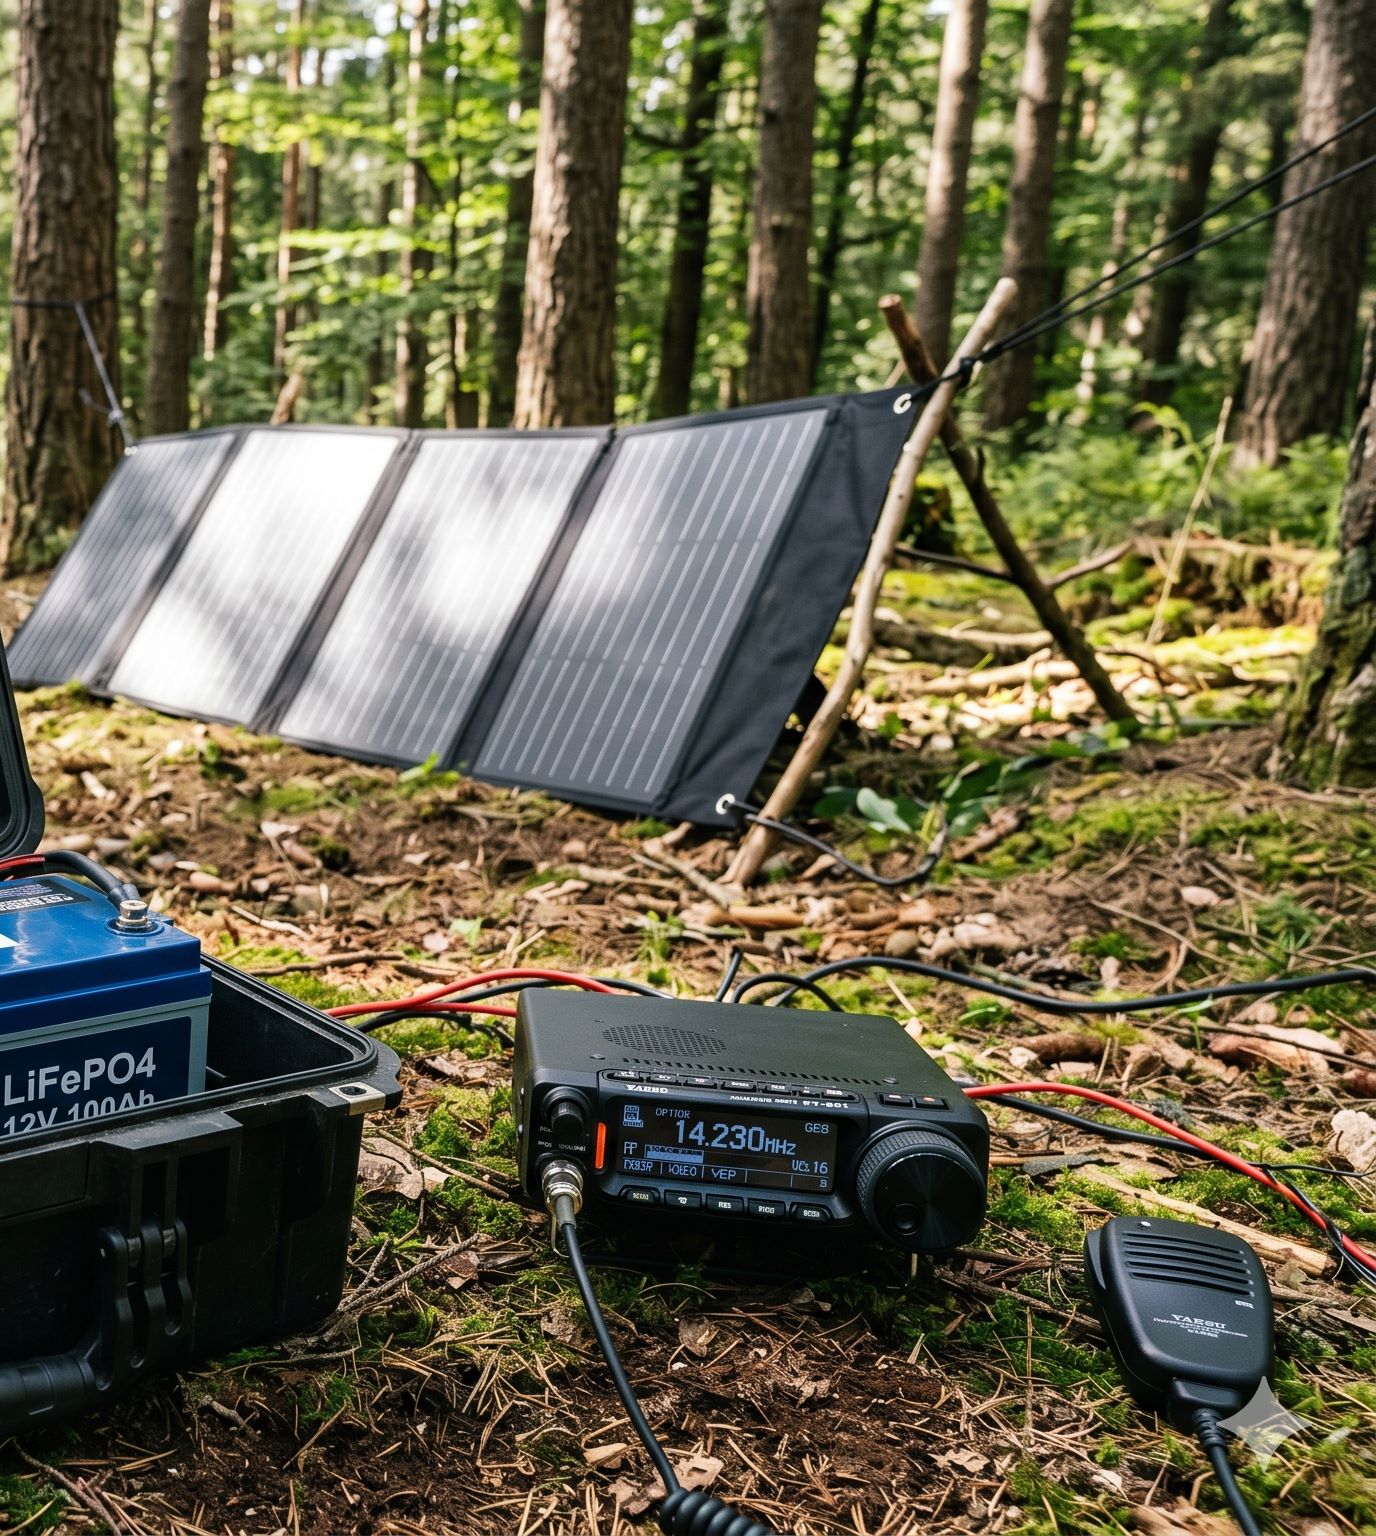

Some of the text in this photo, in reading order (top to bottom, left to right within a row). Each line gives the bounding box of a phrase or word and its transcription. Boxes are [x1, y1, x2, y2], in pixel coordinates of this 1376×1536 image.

[4, 1047, 156, 1106] LiFePO4
[3, 1089, 154, 1135] 12V 100Ah
